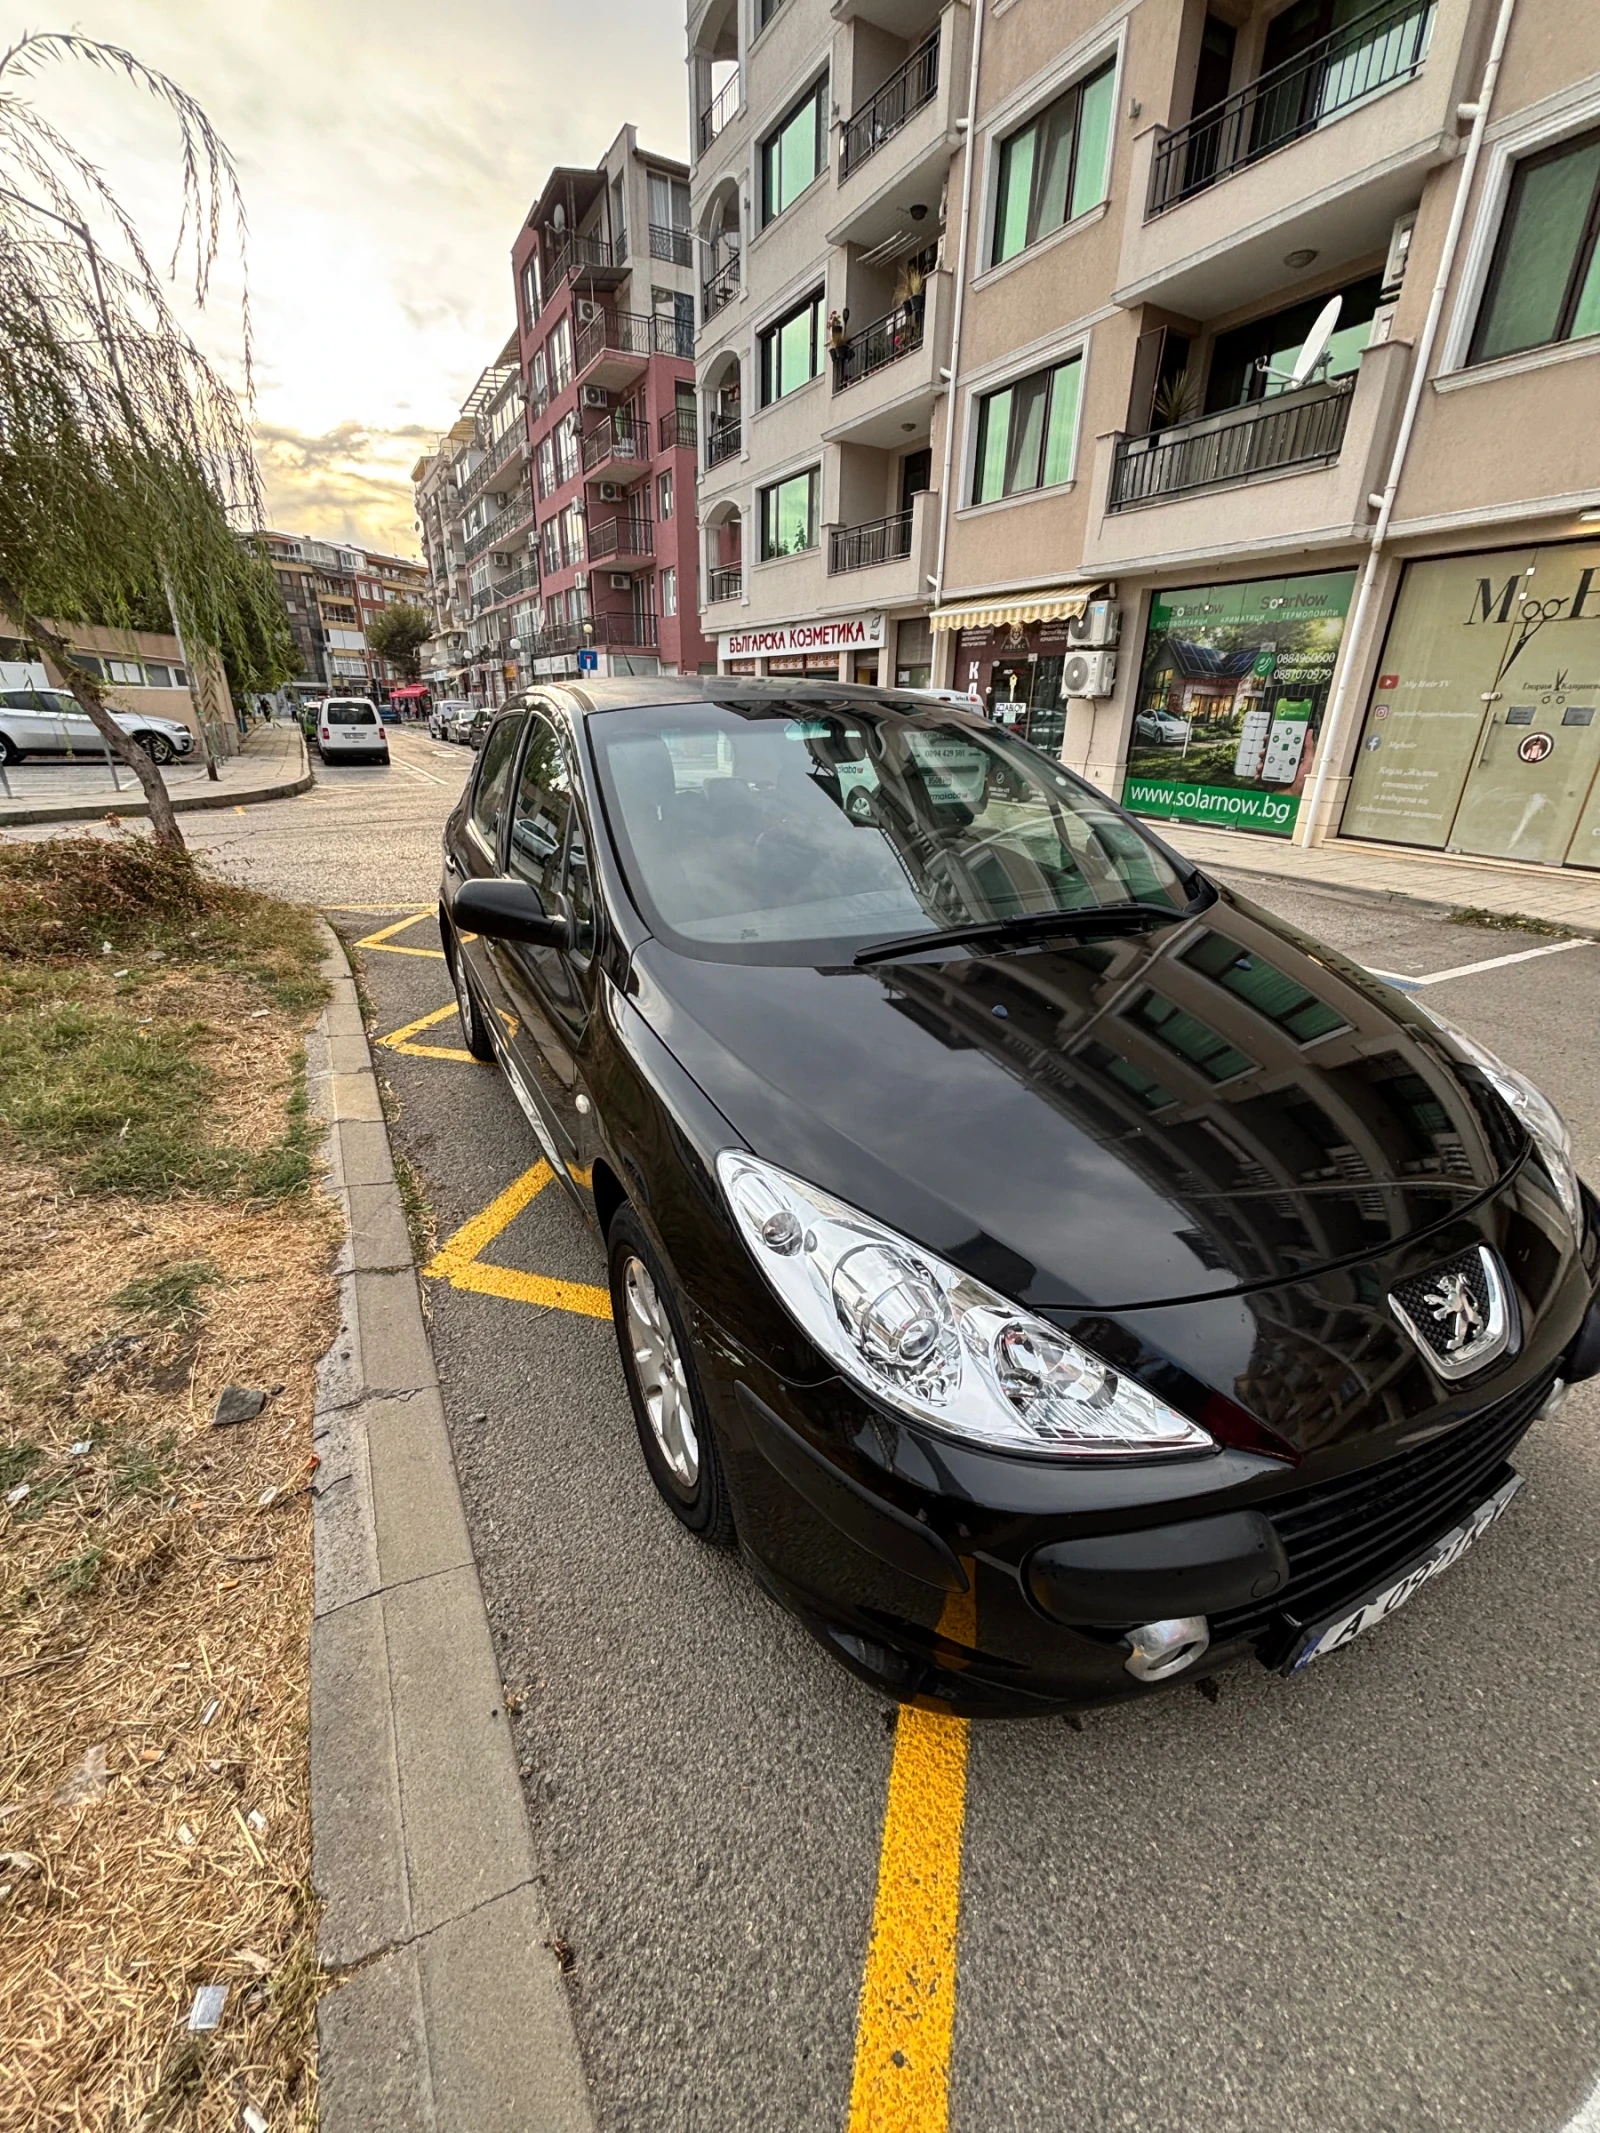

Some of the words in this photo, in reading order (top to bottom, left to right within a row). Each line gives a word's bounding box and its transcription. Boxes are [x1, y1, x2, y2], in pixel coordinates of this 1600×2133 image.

[1259, 592, 1328, 610] SolarNow
[1463, 574, 1525, 625] M
[1170, 602, 1225, 618] SolarNow
[1281, 608, 1339, 619] ТЕРМОПОМПИ
[729, 631, 786, 654] БЪЛГАРСКА
[790, 620, 865, 648] КОЗМЕТИКА
[1276, 652, 1336, 665] 0884960600
[1273, 668, 1332, 680] 0887070979
[1438, 680, 1453, 688] TV
[1130, 785, 1291, 824] www.solarnow.bg
[1332, 1607, 1366, 1646] A
